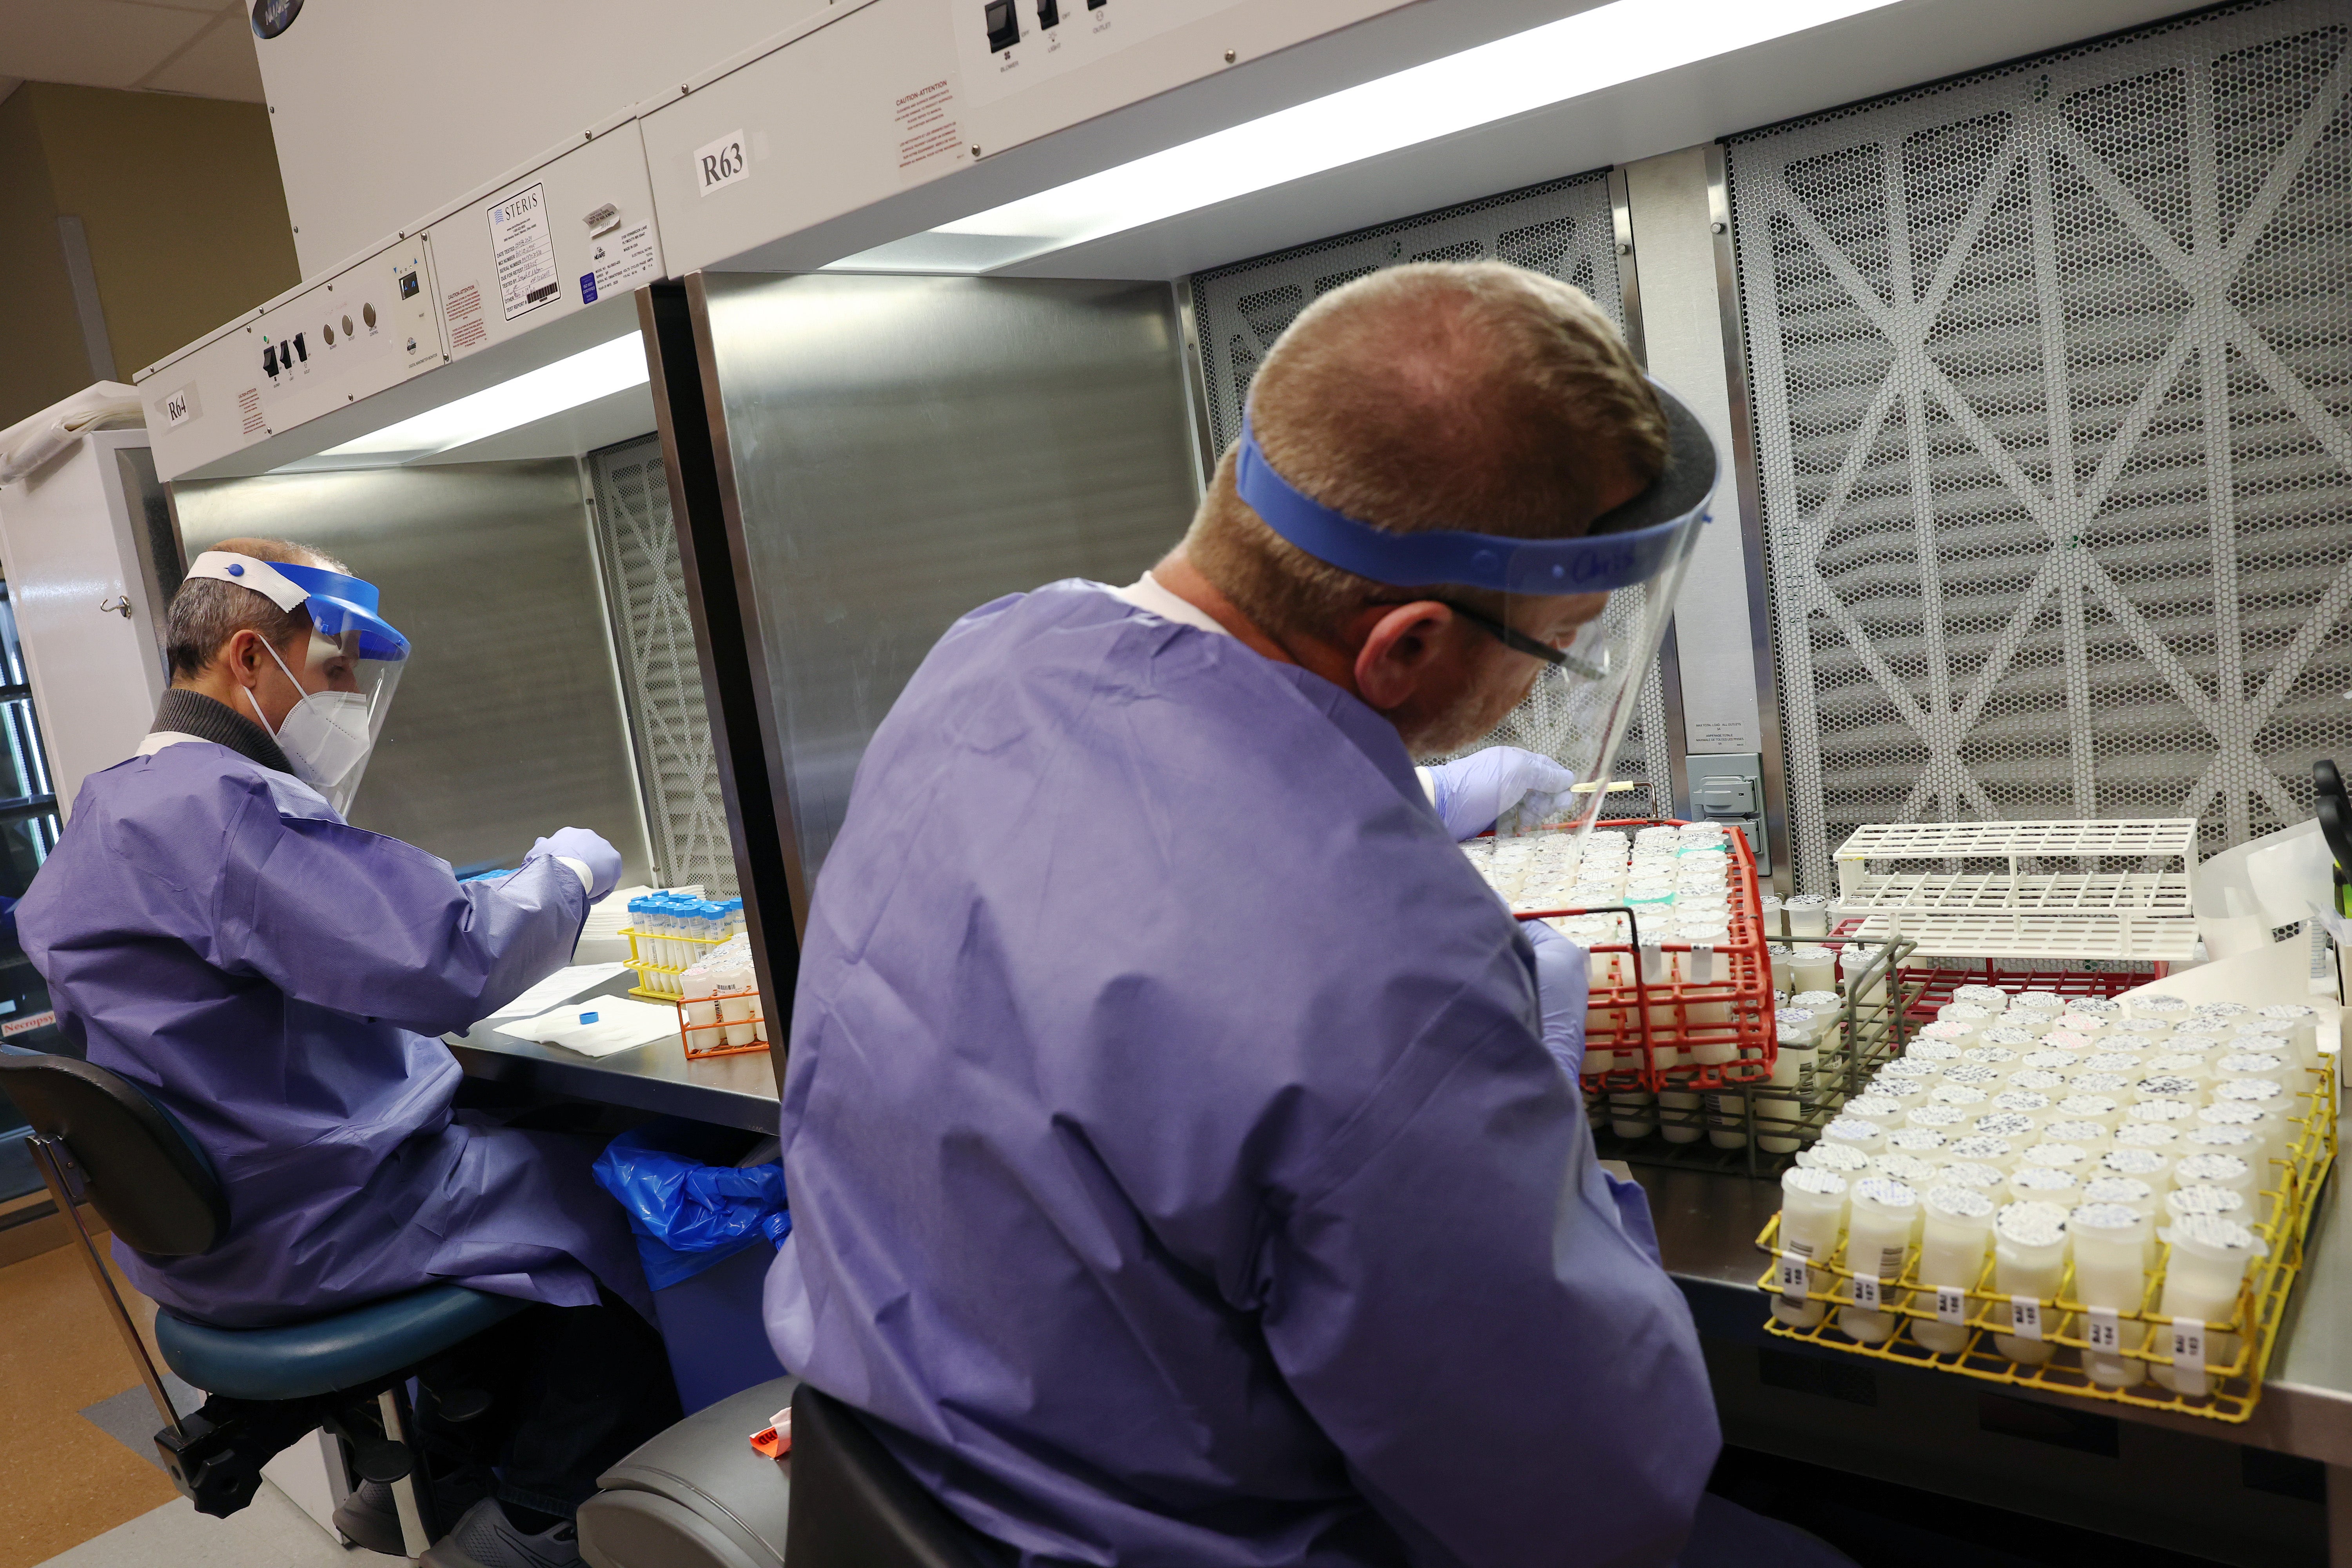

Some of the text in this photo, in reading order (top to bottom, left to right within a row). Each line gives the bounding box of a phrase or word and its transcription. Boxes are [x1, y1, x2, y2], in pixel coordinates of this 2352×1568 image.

[897, 81, 947, 106] CAUTION-ATTENTION
[701, 143, 742, 187] R63
[506, 193, 537, 220] STERIS
[504, 255, 515, 263] NUMBER
[510, 260, 521, 269] NUMBER
[448, 285, 474, 299] CAUTION-ATTENTION
[168, 395, 186, 421] R64
[5, 1015, 54, 1033] Necropsy
